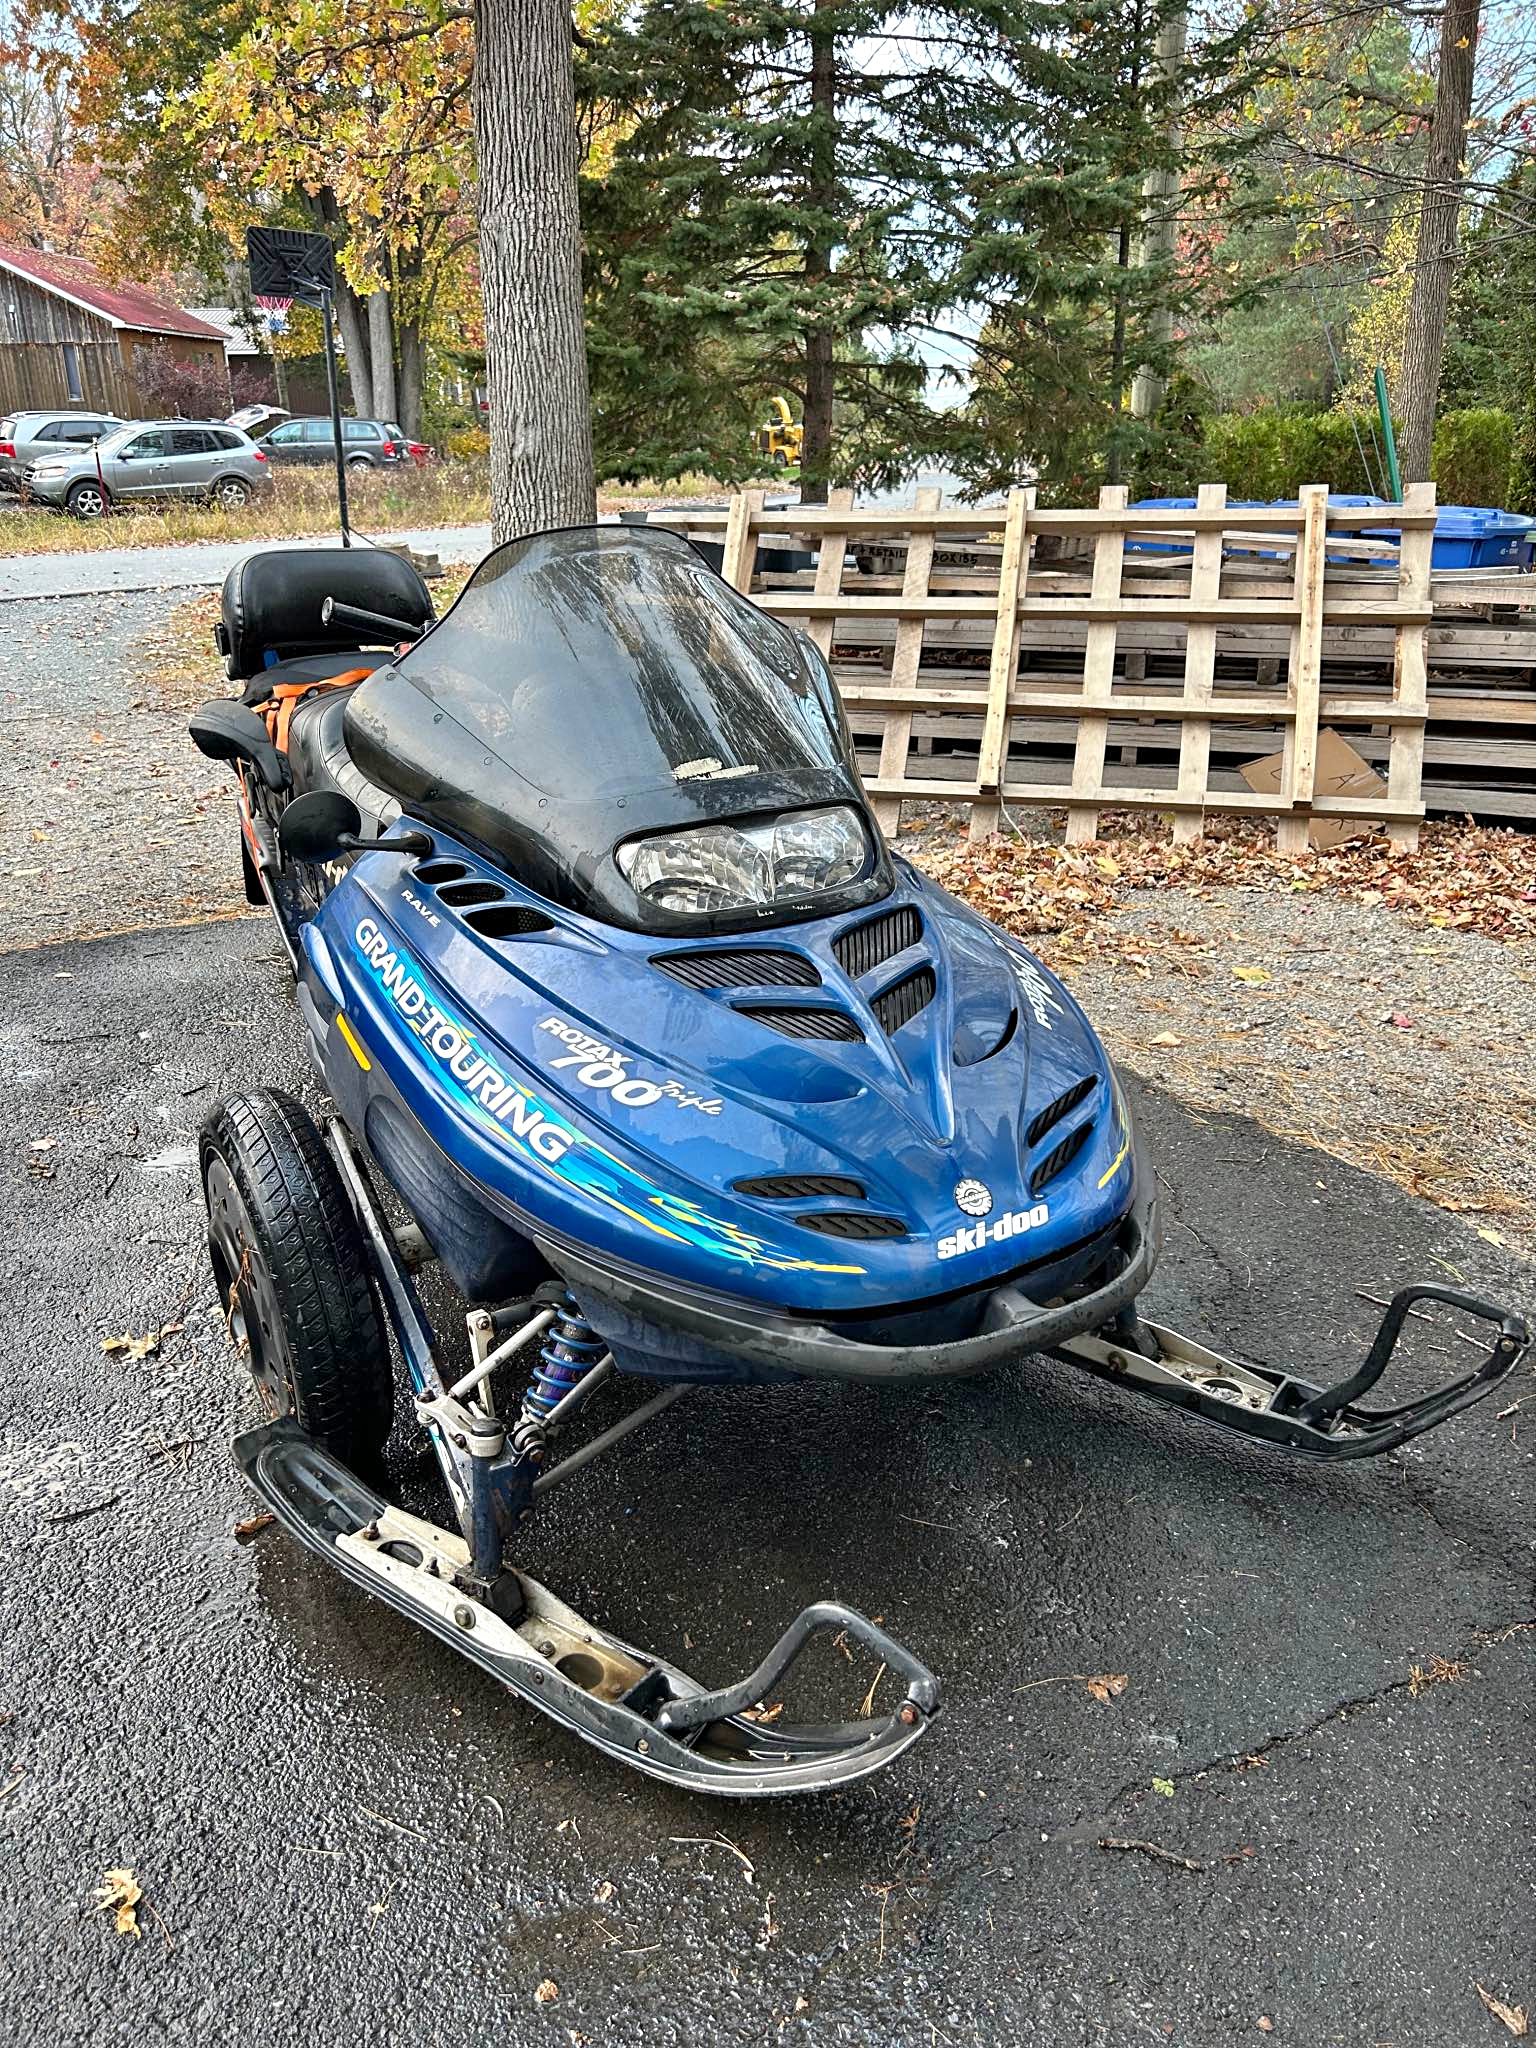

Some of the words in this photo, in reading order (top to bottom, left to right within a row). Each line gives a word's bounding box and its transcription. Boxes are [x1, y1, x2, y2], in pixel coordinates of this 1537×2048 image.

[539, 1016, 634, 1070] ROTAX
[548, 1043, 662, 1106] 700
[656, 1080, 722, 1115] Triple
[936, 1203, 1049, 1260] ski-doo
